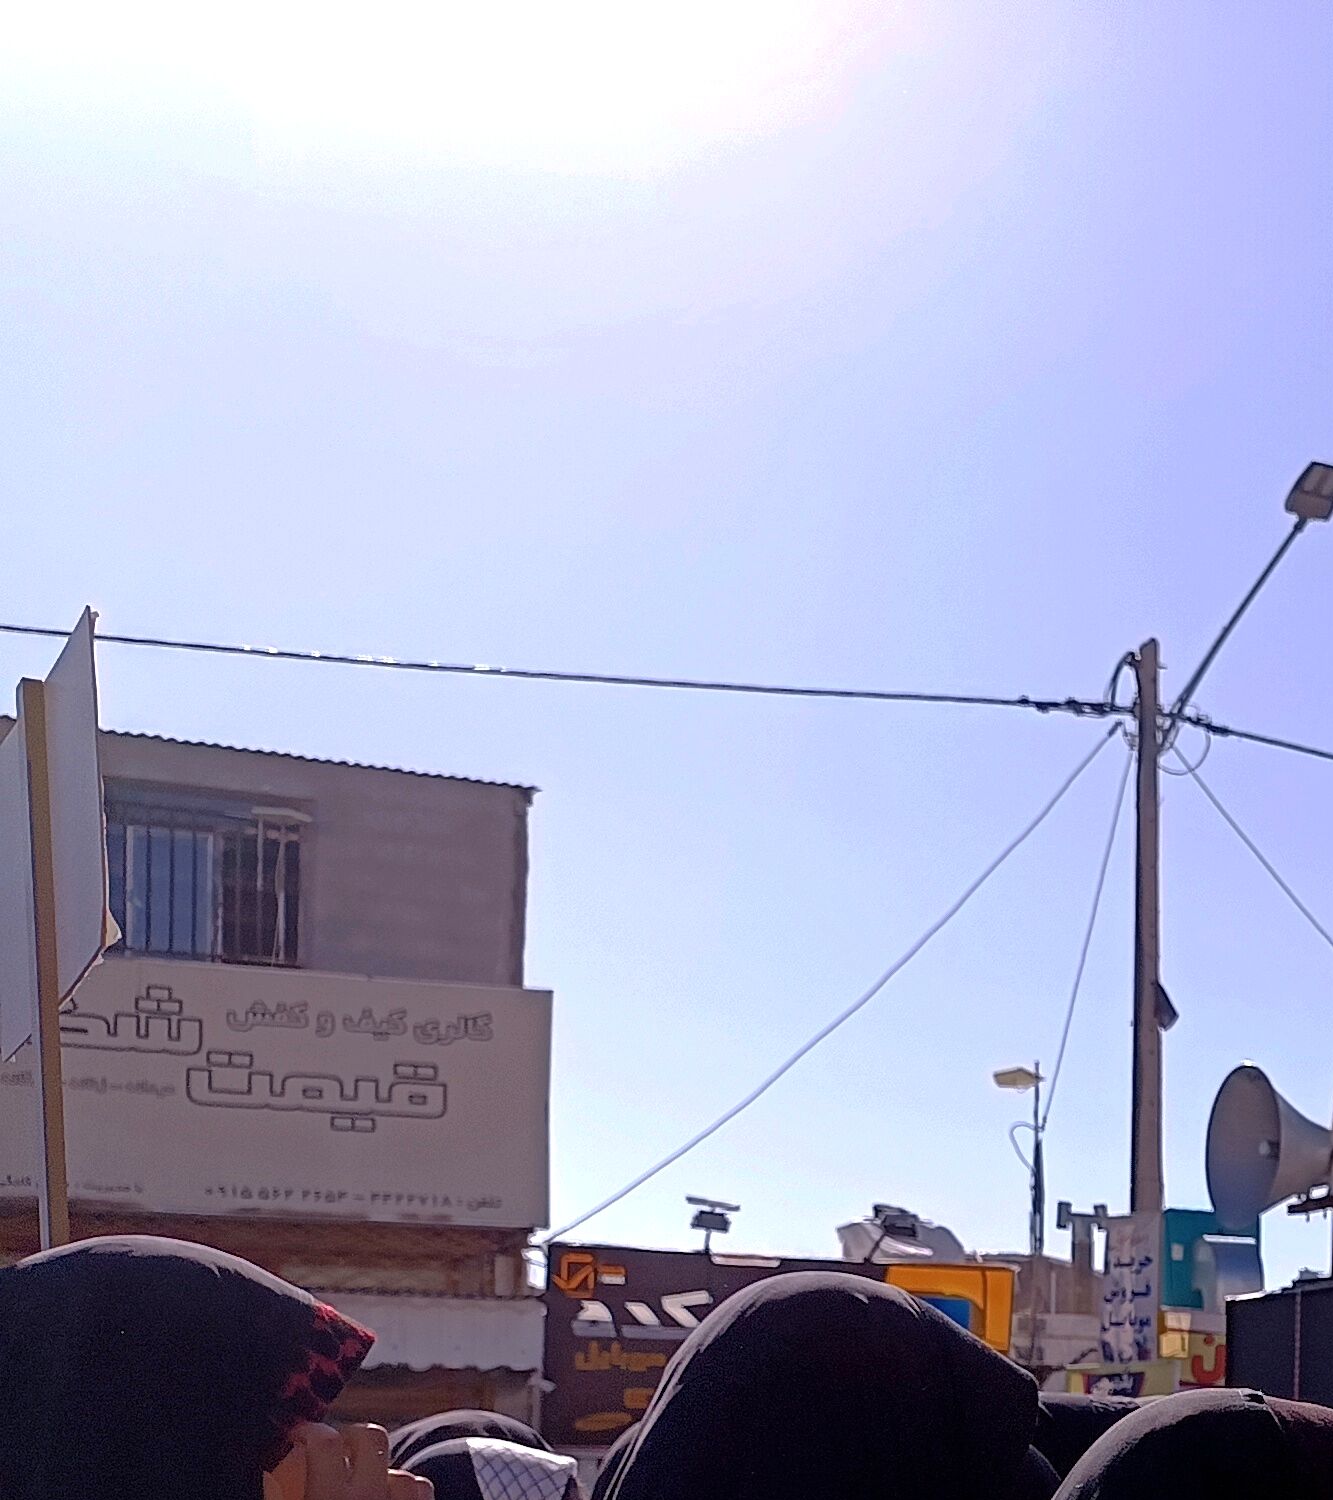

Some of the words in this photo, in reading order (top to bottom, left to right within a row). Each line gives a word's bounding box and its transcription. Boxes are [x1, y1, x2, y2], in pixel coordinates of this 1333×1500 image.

[226, 999, 310, 1033] کفش
[315, 1009, 337, 1039] و
[342, 1006, 409, 1042] کیف
[186, 1049, 449, 1133] قیمت
